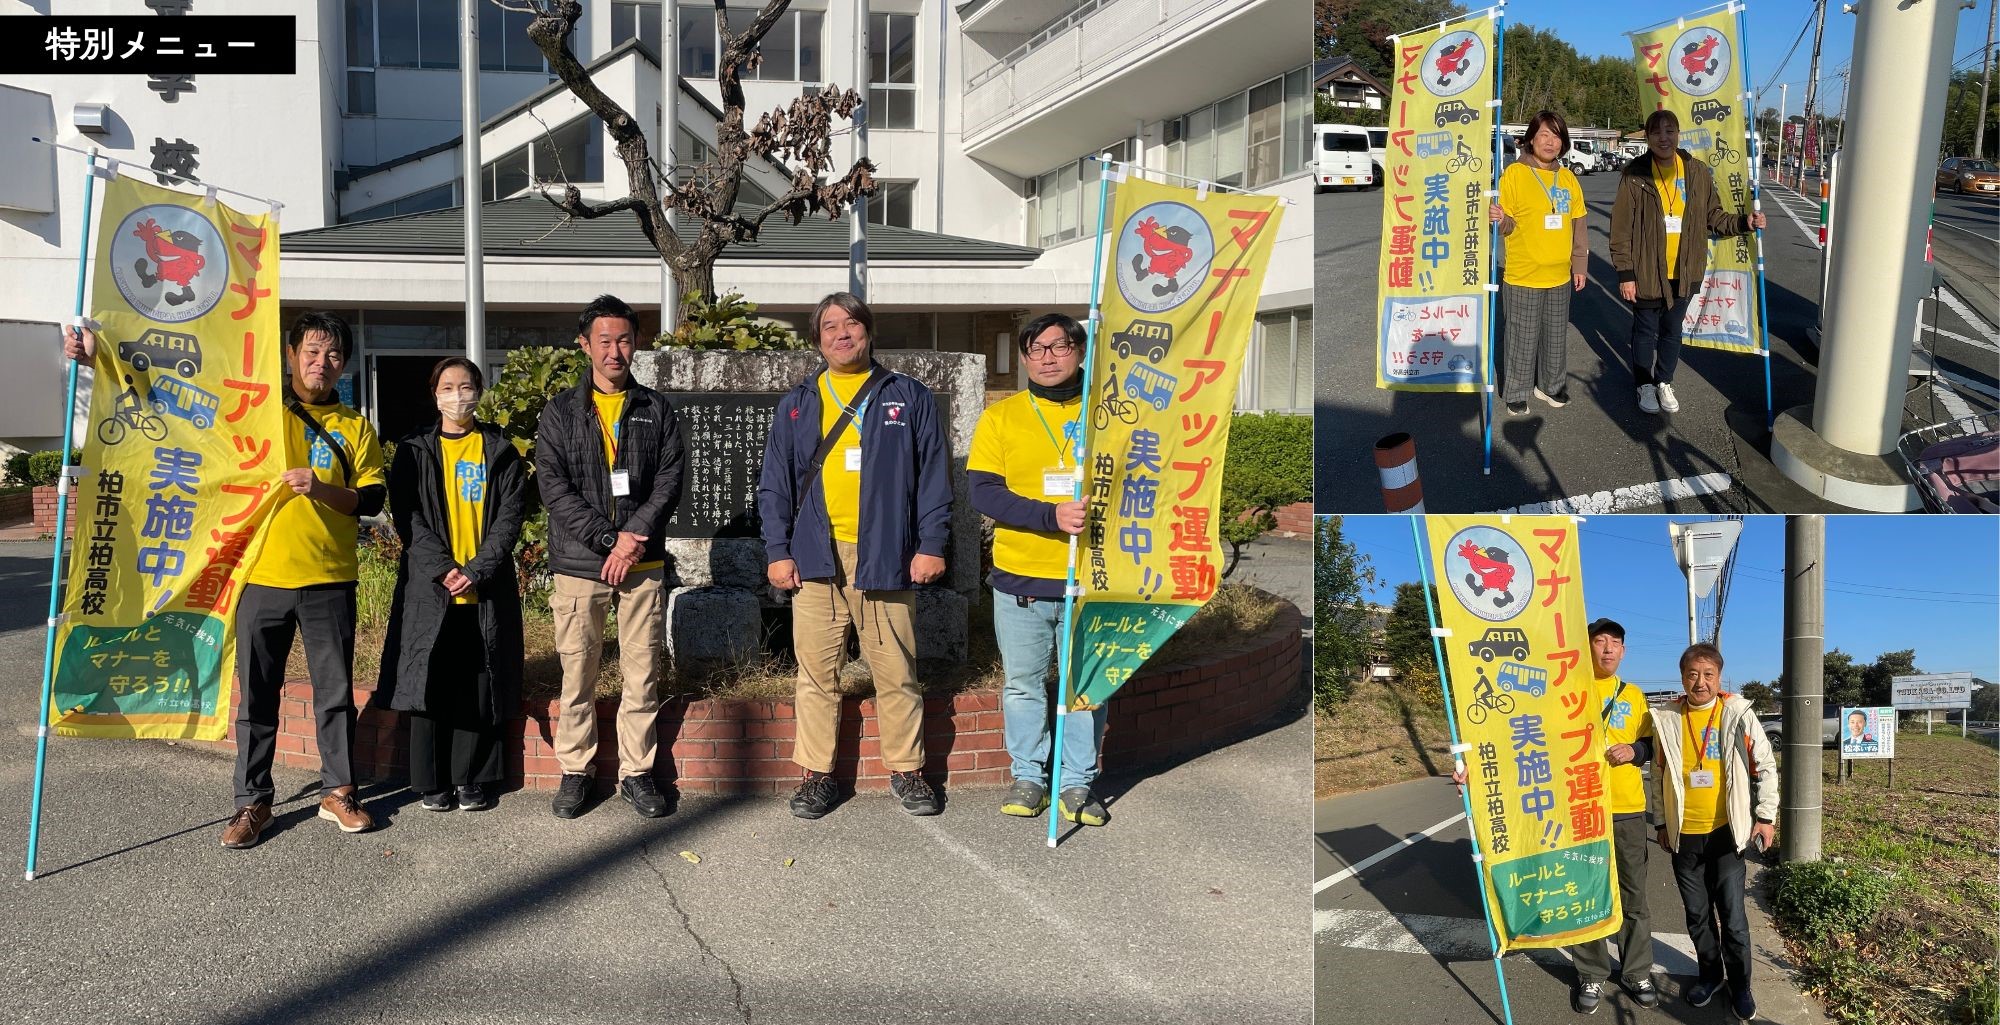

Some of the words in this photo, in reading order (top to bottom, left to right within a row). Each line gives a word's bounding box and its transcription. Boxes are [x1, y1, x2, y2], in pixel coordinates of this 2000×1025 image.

[184, 222, 272, 617] マナーアップ運動
[1168, 209, 1270, 602] マナーアップ運動
[81, 469, 124, 616] 柏市立柏高校
[1090, 452, 1114, 592] 柏市立柏高校
[83, 625, 162, 650] ルールと
[90, 649, 171, 669] マナーを
[1088, 616, 1147, 634] ルールと
[1533, 527, 1606, 843] マナーアップ運動
[1477, 742, 1511, 855] 柏市立柏高校
[1509, 713, 1564, 849] 実施中!!
[1508, 862, 1567, 889] ルールと
[1519, 881, 1579, 907] マナーを
